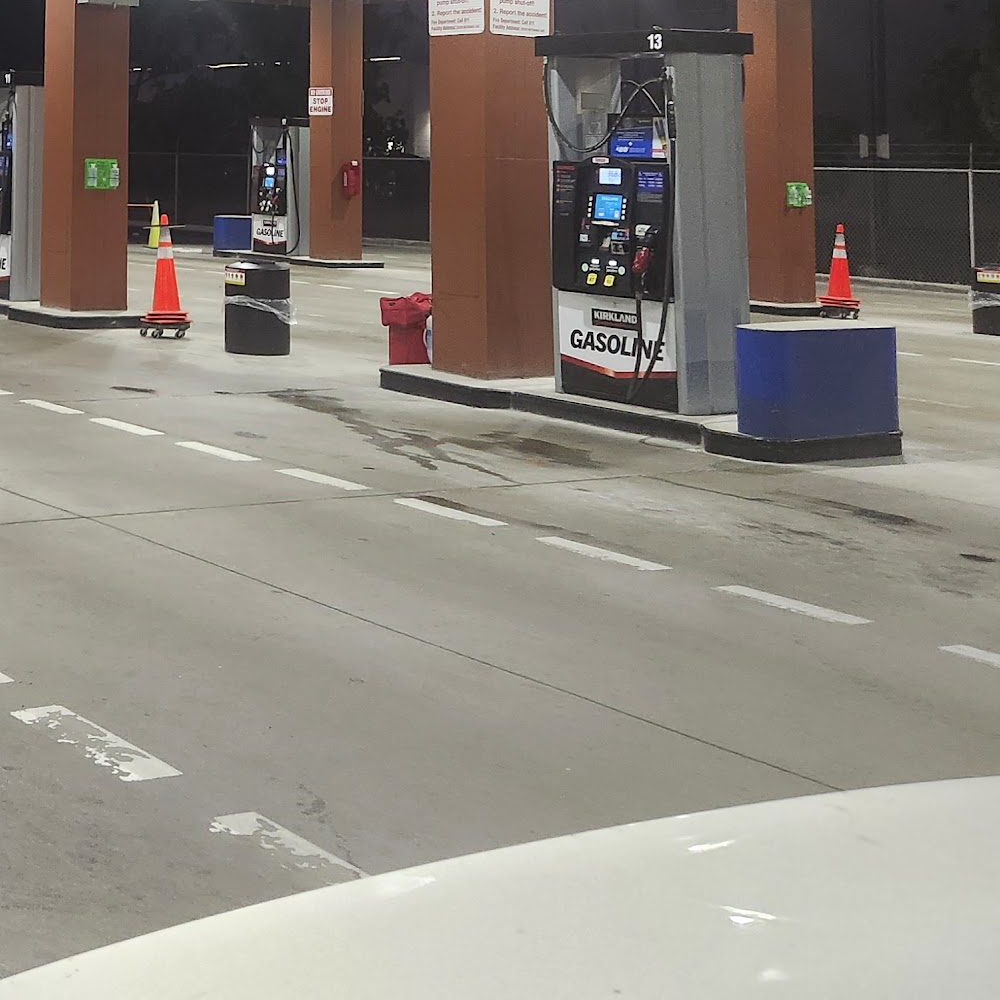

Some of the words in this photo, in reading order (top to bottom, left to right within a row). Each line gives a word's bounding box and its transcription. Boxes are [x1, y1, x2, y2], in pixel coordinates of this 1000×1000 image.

[647, 33, 662, 50] 13
[5, 74, 10, 83] 11
[594, 310, 638, 324] KIRKLAND
[570, 329, 665, 361] GASOLINE
